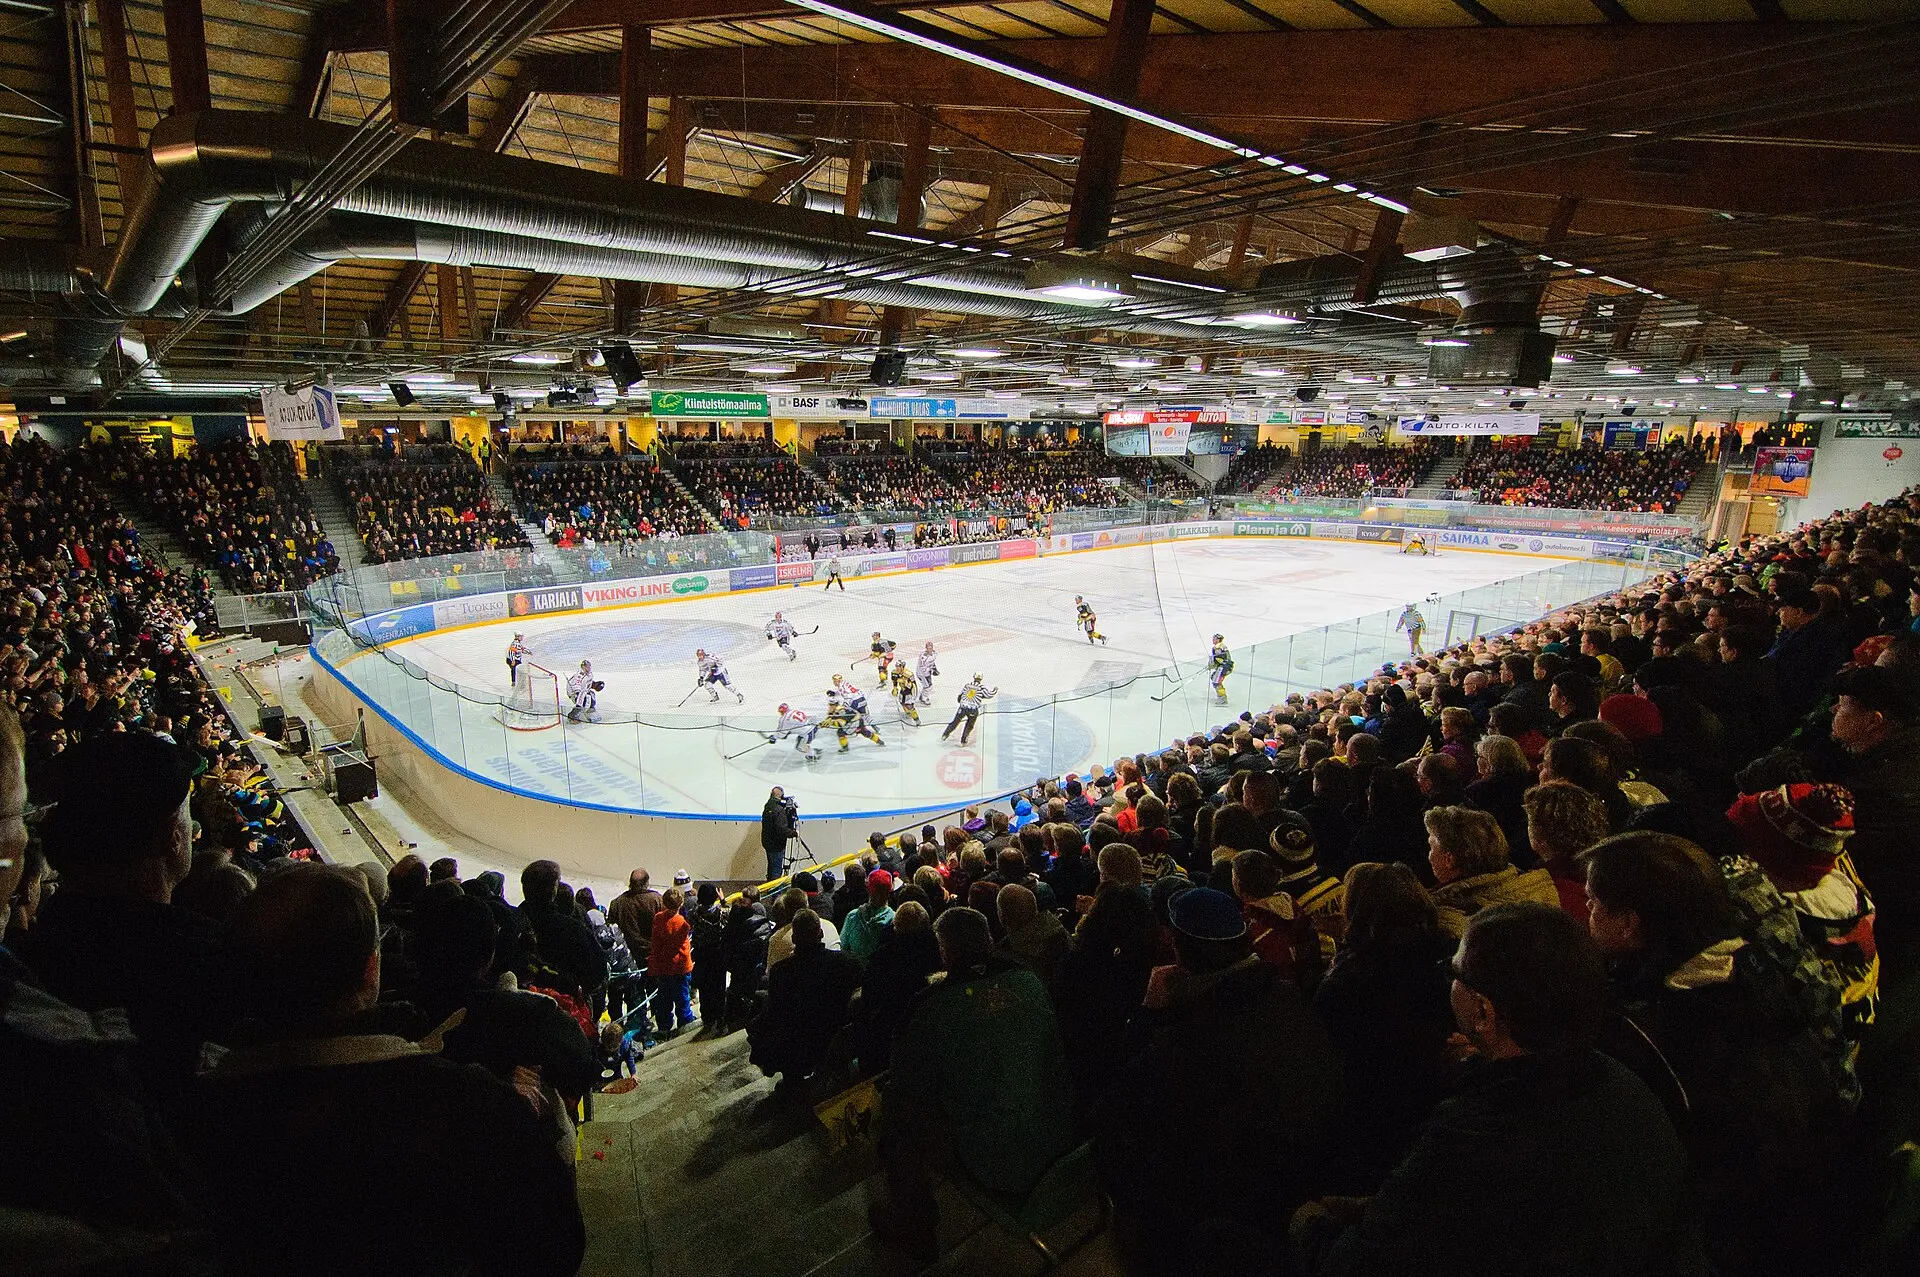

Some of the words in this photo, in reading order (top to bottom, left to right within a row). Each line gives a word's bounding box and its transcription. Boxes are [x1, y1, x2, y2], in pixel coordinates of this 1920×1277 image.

[684, 397, 762, 411] Kiinteistömaailma
[793, 398, 820, 407] BASF
[1238, 524, 1288, 536] Plannja
[583, 587, 638, 603] VIKING
[640, 582, 671, 597] LINE
[533, 590, 579, 611] KARJALA
